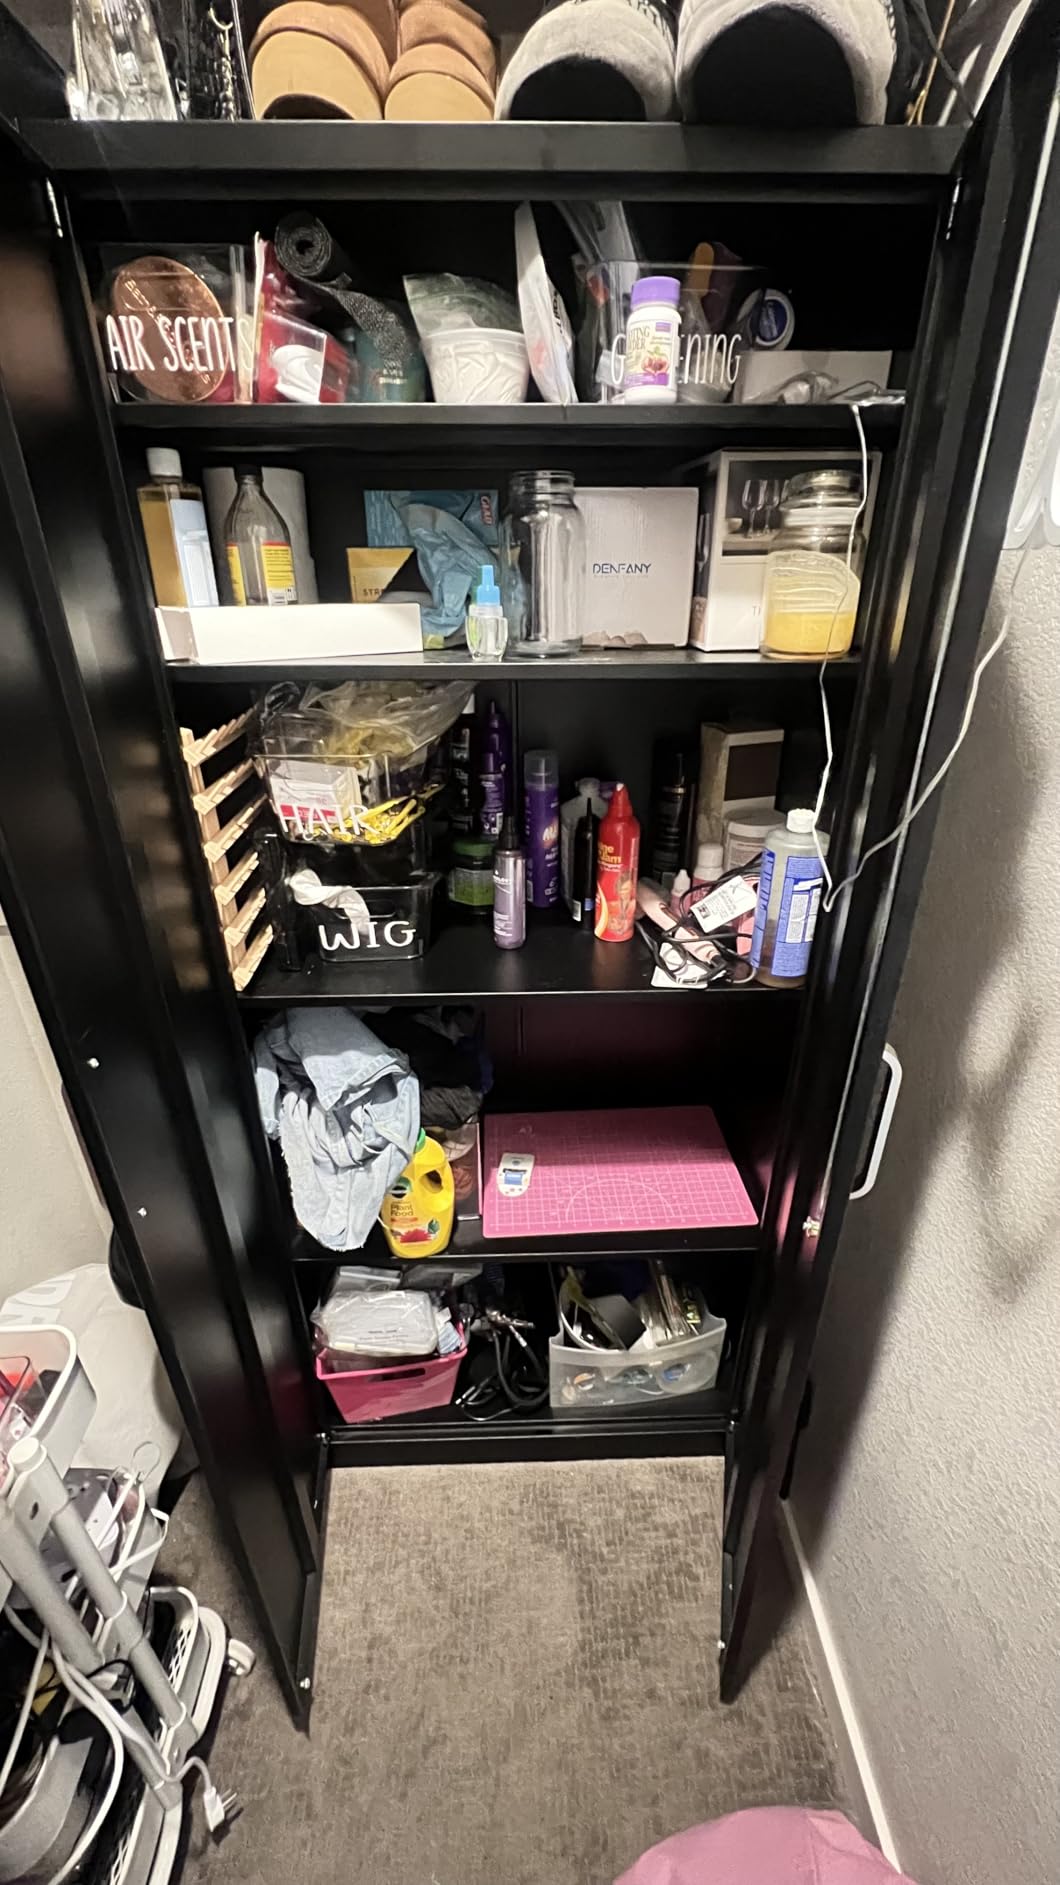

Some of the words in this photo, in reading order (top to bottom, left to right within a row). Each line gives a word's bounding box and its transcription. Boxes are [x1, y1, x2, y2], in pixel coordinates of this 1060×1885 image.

[106, 314, 155, 371] AIR
[593, 563, 652, 574] DENFANY
[277, 803, 380, 835] HAIR
[318, 921, 416, 951] WIG
[391, 1203, 413, 1211] Plant
